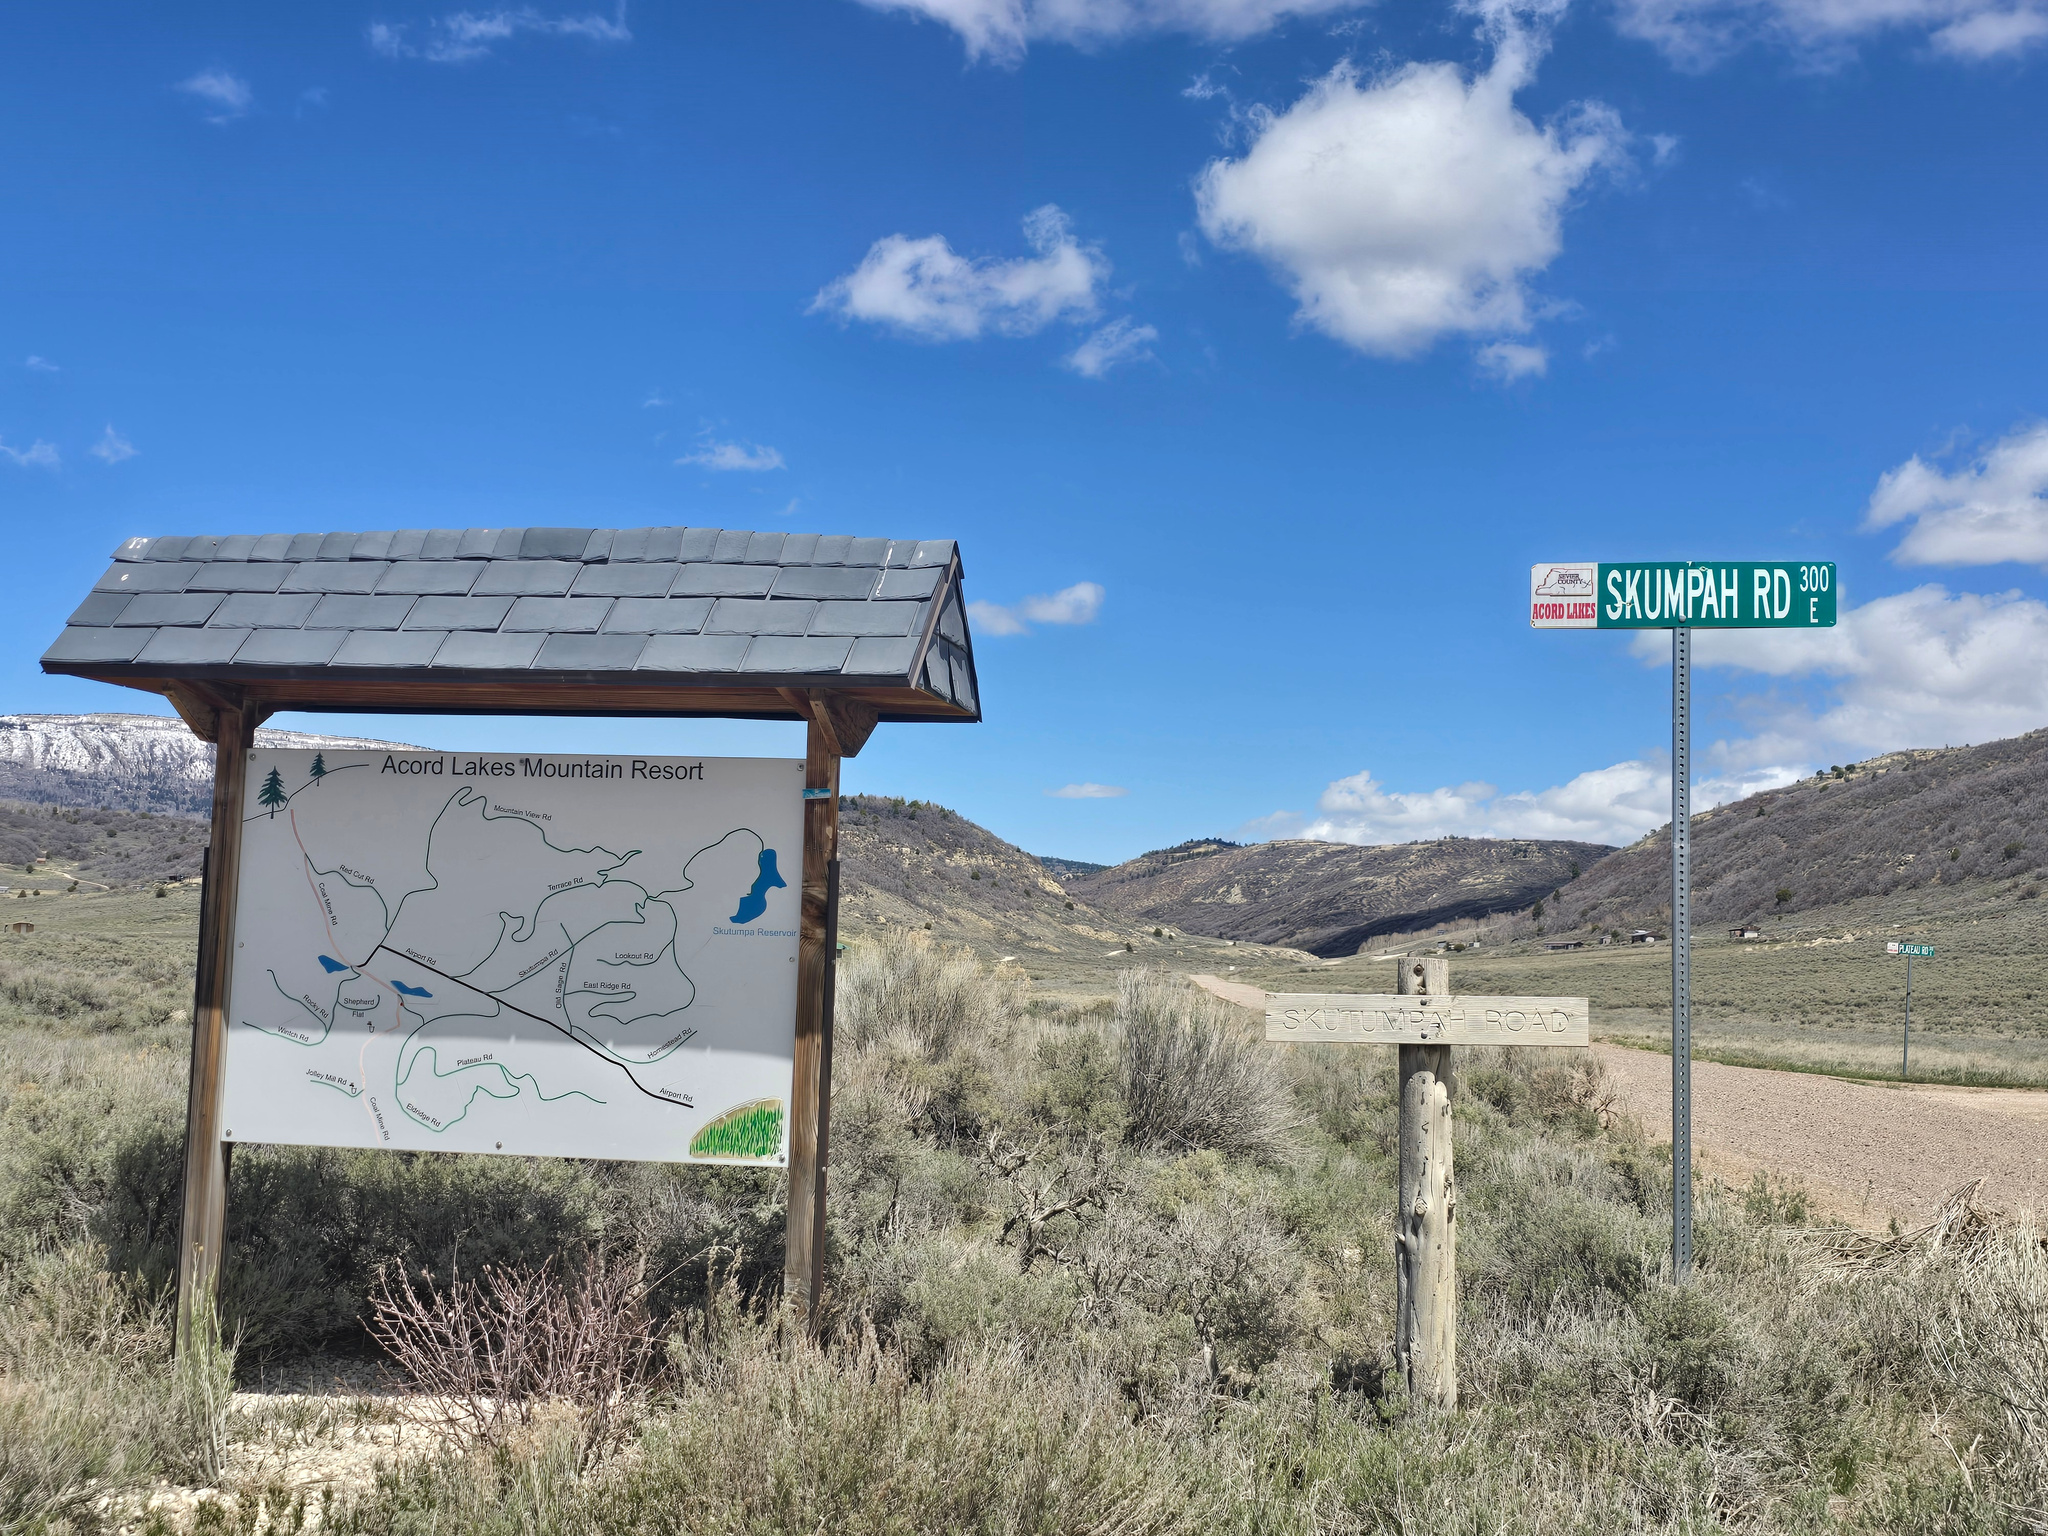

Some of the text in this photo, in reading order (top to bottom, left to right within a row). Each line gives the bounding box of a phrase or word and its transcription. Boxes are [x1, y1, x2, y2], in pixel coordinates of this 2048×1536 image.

[1800, 565, 1830, 592] 300
[1605, 568, 1791, 620] SKUMPAH RD
[1532, 602, 1596, 620] ACORD LAKES
[1810, 597, 1819, 623] E
[381, 755, 704, 780] Acord Lakes Mountain Resort
[494, 804, 524, 816] Mountain
[525, 810, 541, 818] View
[340, 864, 375, 884] Red Cut Rd
[548, 876, 584, 890] Terrace Rd
[318, 882, 338, 926] Coal Mine Rd
[712, 926, 797, 938] Skutumpa Reservoir
[406, 948, 437, 966] Airport Rd
[1899, 944, 1920, 954] PLATEAU
[1922, 946, 1929, 955] RD
[518, 948, 559, 978] Skutumpa Rd
[556, 975, 564, 994] Sage
[560, 962, 566, 973] Rd
[600, 982, 620, 990] Ridge
[302, 994, 330, 1018] Rocky Rd
[343, 998, 375, 1006] Shepherd
[1282, 1008, 1571, 1034] SKUTUMPAH ROAD
[299, 1033, 310, 1042] Rd
[647, 1028, 692, 1059] Homestead Rd
[456, 1057, 482, 1066] Plateau
[306, 1069, 348, 1086] Jolley Mill Rd
[660, 1087, 693, 1102] Airport Rd
[370, 1096, 390, 1141] Coal Mine Rd
[406, 1102, 441, 1128] Eldridge Rd
